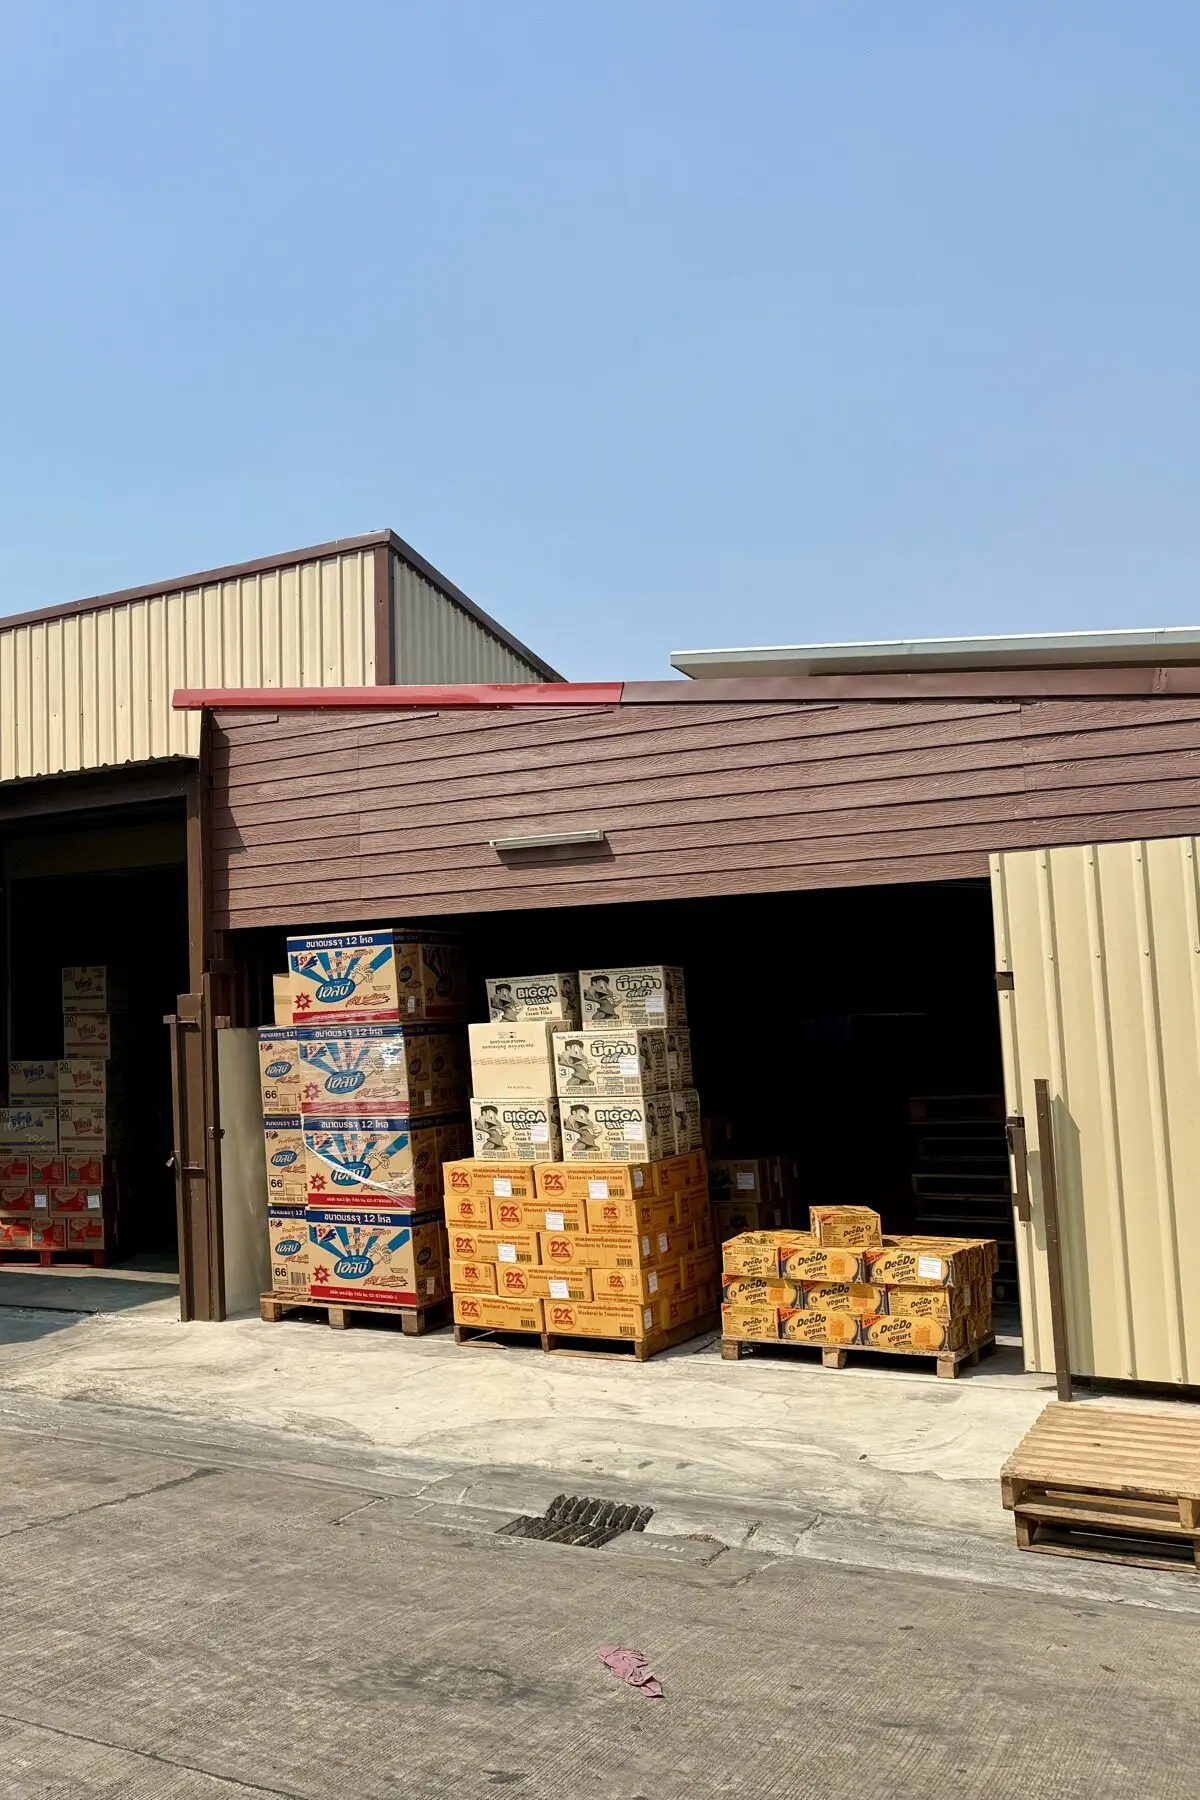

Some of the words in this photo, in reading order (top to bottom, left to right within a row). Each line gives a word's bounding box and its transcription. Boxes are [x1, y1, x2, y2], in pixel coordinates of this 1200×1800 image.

[306, 940, 343, 948] ขนาดบรรจุ
[360, 936, 374, 944] โหล
[517, 986, 557, 998] BIGGA
[314, 1029, 352, 1038] ขนาดบรรจุ
[60, 1062, 69, 1071] 20
[265, 1090, 277, 1098] 66
[61, 1109, 69, 1118] 20
[504, 1111, 546, 1122] BIGGA
[595, 1109, 642, 1122] BIGGA
[321, 1120, 358, 1130] ขนาดบรรจุ
[362, 1120, 372, 1128] 12
[376, 1120, 389, 1128] โหล
[451, 1172, 468, 1183] DK
[544, 1174, 562, 1186] DK
[270, 1180, 283, 1188] 66
[460, 1203, 473, 1211] DK
[500, 1206, 518, 1218] DK
[603, 1207, 617, 1216] DK
[324, 1214, 361, 1224] ขนาดบรรจุ
[377, 1216, 392, 1224] โหล
[843, 1226, 864, 1237] DeeDo
[456, 1237, 473, 1248] DK
[550, 1241, 570, 1253] DK
[743, 1257, 762, 1267] DeeDo
[798, 1252, 827, 1266] DeeDo
[884, 1255, 915, 1270] DeeDo
[274, 1268, 287, 1277] 66
[464, 1267, 476, 1275] DK
[804, 1264, 827, 1275] yogurt
[892, 1268, 915, 1279] yogurt
[505, 1272, 523, 1284] DK
[609, 1276, 623, 1284] DK
[738, 1278, 767, 1292] DeeDo
[745, 1292, 766, 1300] yogurt
[819, 1284, 849, 1298] DeeDo
[461, 1300, 478, 1312] DK
[826, 1297, 849, 1307] yogurt
[911, 1298, 932, 1308] DeeDo
[553, 1308, 572, 1320] DK
[743, 1318, 762, 1326] DeeDo
[797, 1314, 826, 1327] DeeDo
[804, 1326, 826, 1336] yogurt
[880, 1320, 912, 1334] DeeDo
[888, 1332, 911, 1343] yogurt
